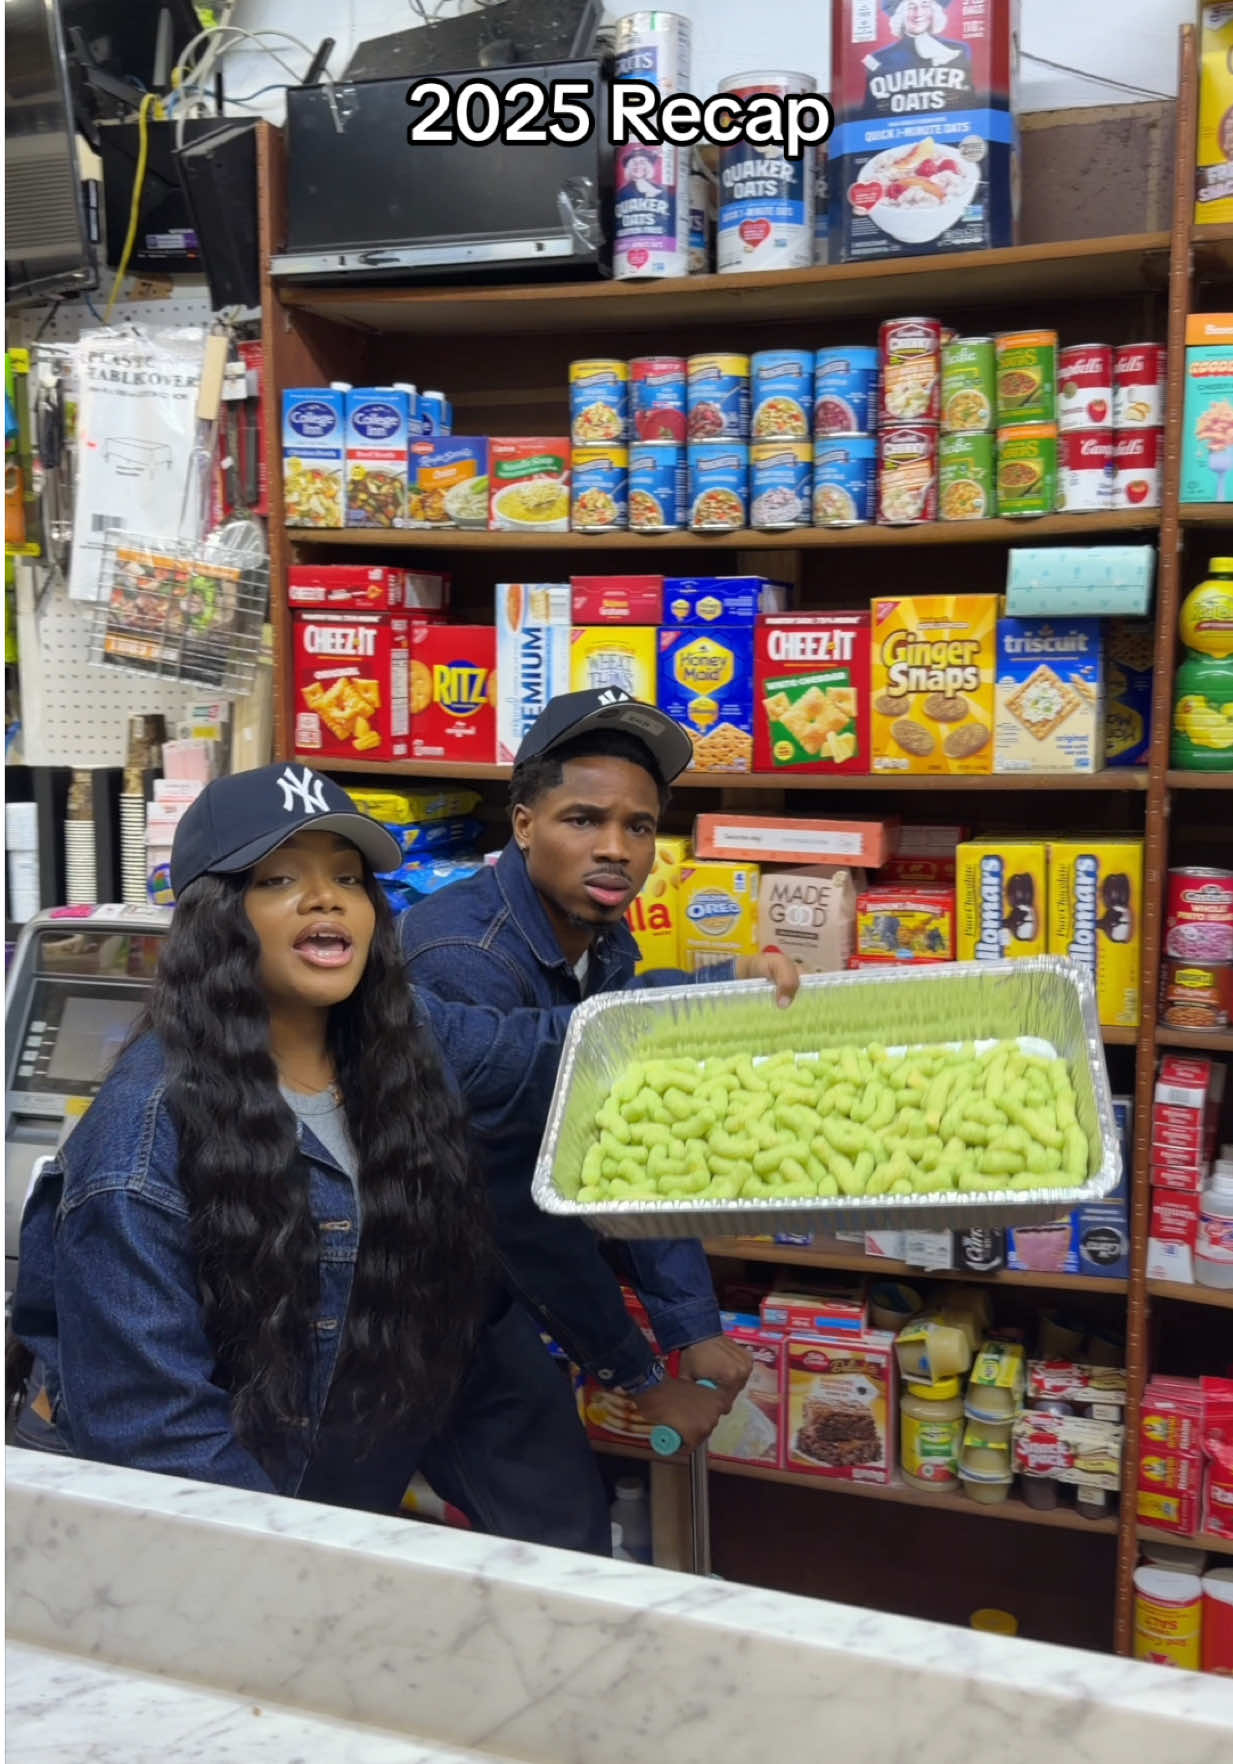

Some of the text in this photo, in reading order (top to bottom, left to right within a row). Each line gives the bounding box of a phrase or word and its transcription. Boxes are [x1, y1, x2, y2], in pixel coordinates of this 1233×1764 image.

[870, 68, 968, 100] QUAKER
[890, 91, 946, 113] OATS
[721, 160, 796, 188] QUAKER
[733, 180, 778, 199] OATS
[882, 629, 980, 672] Ginger
[1004, 631, 1089, 654] triscuit
[432, 664, 488, 705] RITZ
[887, 662, 979, 699] Snaps
[277, 766, 331, 814] NY
[769, 886, 832, 907] MADE
[974, 857, 1001, 961] llomars
[1068, 856, 1097, 968] llomars
[768, 903, 827, 928] GOOD
